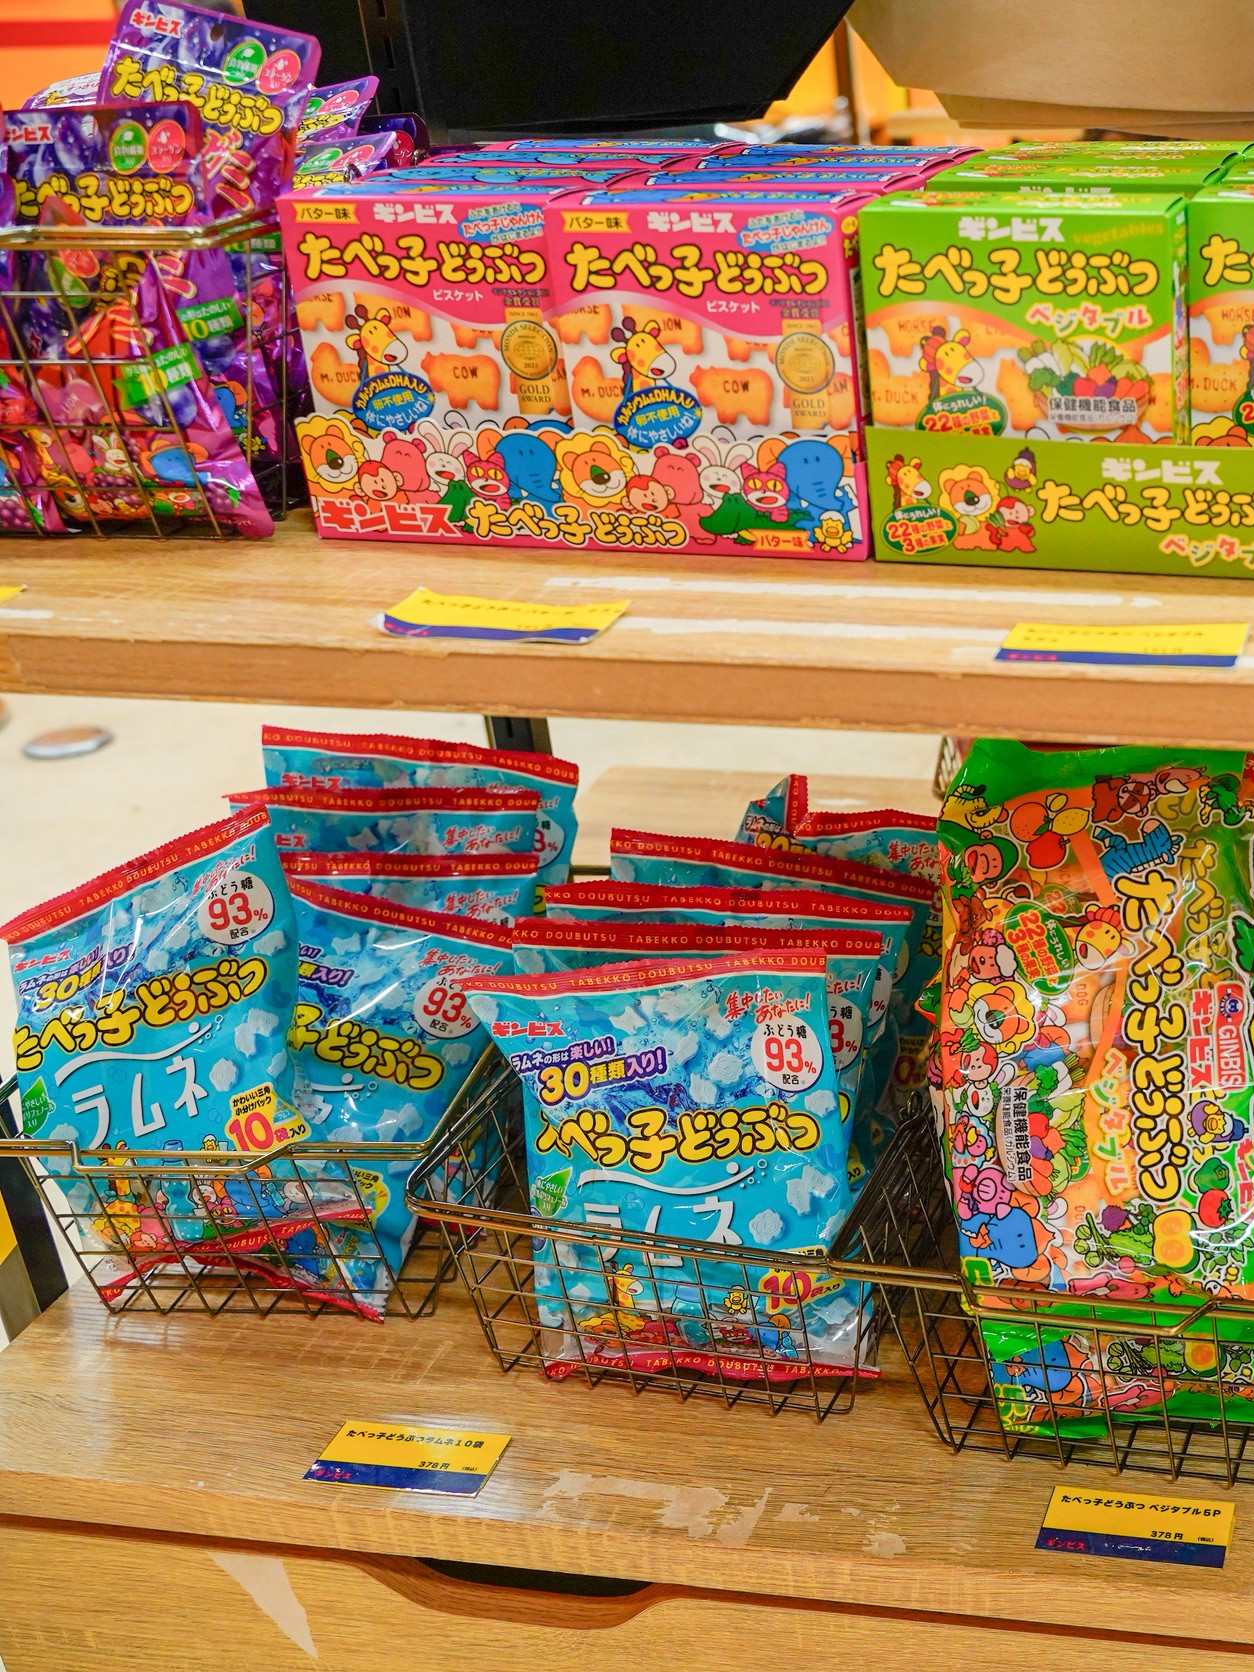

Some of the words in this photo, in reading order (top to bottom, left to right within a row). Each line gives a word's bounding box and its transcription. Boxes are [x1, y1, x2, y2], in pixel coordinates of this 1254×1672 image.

[300, 209, 352, 221] バター味
[373, 203, 457, 224] ギンビス
[462, 210, 545, 237] たべっ子じゃんけん
[569, 216, 622, 230] バター味
[647, 211, 736, 234] ギンビス
[740, 217, 831, 247] たべっ子じゃんけん
[959, 217, 1065, 242] ギンビス
[1073, 223, 1164, 247] vegetables
[298, 232, 547, 286] たべっ子どうぶつ
[564, 242, 829, 297] たべっ子どうぶつ
[873, 243, 1159, 304] たべっ子どうぶつ
[432, 289, 484, 301] ビスケット
[706, 300, 761, 313] ビスケット
[1027, 303, 1151, 337] ベジタブル
[453, 366, 478, 380] COW
[1204, 376, 1237, 392] DUCK
[519, 384, 551, 395] GOLD
[723, 380, 750, 394] COW
[887, 390, 920, 405] DUCK
[372, 390, 414, 411] 卵不使用
[521, 395, 552, 403] AWARD
[792, 399, 826, 409] GOLD
[1050, 398, 1136, 413] 保健機能食品
[636, 405, 680, 426] 卵不使用
[794, 410, 827, 418] AWARD
[1101, 457, 1223, 486] ギンビス
[320, 500, 461, 536] ギンビス
[466, 499, 688, 548] たべっ子どうぶつ
[759, 536, 804, 549] バター味
[286, 734, 351, 748] DOUBUTSU
[362, 741, 414, 756] TABEKKO
[419, 747, 483, 761] DOUBUTSU
[492, 756, 541, 772] TABEKKO
[323, 796, 373, 808] TABEKKO
[379, 797, 442, 808] DOUBUTSU
[452, 797, 503, 808] TABEKKO
[325, 861, 370, 872] TABEKKO
[375, 862, 441, 873] DOUBUTSU
[451, 861, 500, 872] TABEKKO
[637, 842, 701, 856] DOUBUTSU
[712, 850, 763, 865] TABEKKO
[768, 859, 833, 877] DOUBUTSU
[843, 871, 896, 890] TABEKKO
[21, 905, 72, 932] DOUBUTSU
[79, 880, 125, 907] TABEKKO
[126, 854, 180, 884] DOUBUTSU
[185, 828, 237, 857] TABEKKO
[208, 892, 269, 931] 93%
[579, 892, 651, 905] DOUBUTSU
[662, 895, 722, 908] TABEKKO
[729, 898, 800, 911] DOUBUTSU
[811, 902, 868, 916] TABEKKO
[318, 895, 369, 913] TABEKKO
[374, 907, 436, 927] DOUBUTSU
[446, 922, 494, 941] TABEKKO
[229, 929, 250, 940] 配合
[546, 931, 617, 943] DOUBUTSU
[628, 934, 689, 947] TABEKKO
[696, 936, 768, 948] DOUBUTSU
[780, 938, 838, 950] TABEKKO
[14, 949, 72, 973] ギンビス
[488, 979, 557, 991] DOUBUTSU
[569, 973, 631, 989] TABEKKO
[637, 961, 714, 982] DOUBUTSU
[724, 956, 785, 969] TABEKKO
[725, 990, 785, 1021] 集中したい
[754, 992, 812, 1025] あなたに!
[430, 1018, 449, 1032] 配合
[492, 1021, 565, 1037] ギンビス
[762, 1022, 807, 1039] ぶどう糖
[1115, 870, 1188, 1202] たべっ子どうぶつ
[1190, 988, 1215, 1088] ギンビス
[764, 1037, 817, 1074] 93%
[1218, 1024, 1246, 1089] GINBIS
[538, 1046, 667, 1105] 30種類入り!
[782, 1073, 801, 1086] 配合
[58, 1034, 211, 1149] ラムネ
[233, 1086, 272, 1107] かわいい三角
[235, 1096, 273, 1116] 小分けパック
[1089, 1048, 1135, 1197] ベジタブル
[1013, 1087, 1033, 1182] 保健機能食品
[347, 1429, 484, 1449] たべっ子どうぶつラムネ10袋
[1061, 1495, 1146, 1510] たべっ子どうぶつ
[1149, 1504, 1222, 1518] ベジタブル5P
[1046, 1539, 1086, 1550] ギンビス
[1150, 1530, 1184, 1541] 378円
